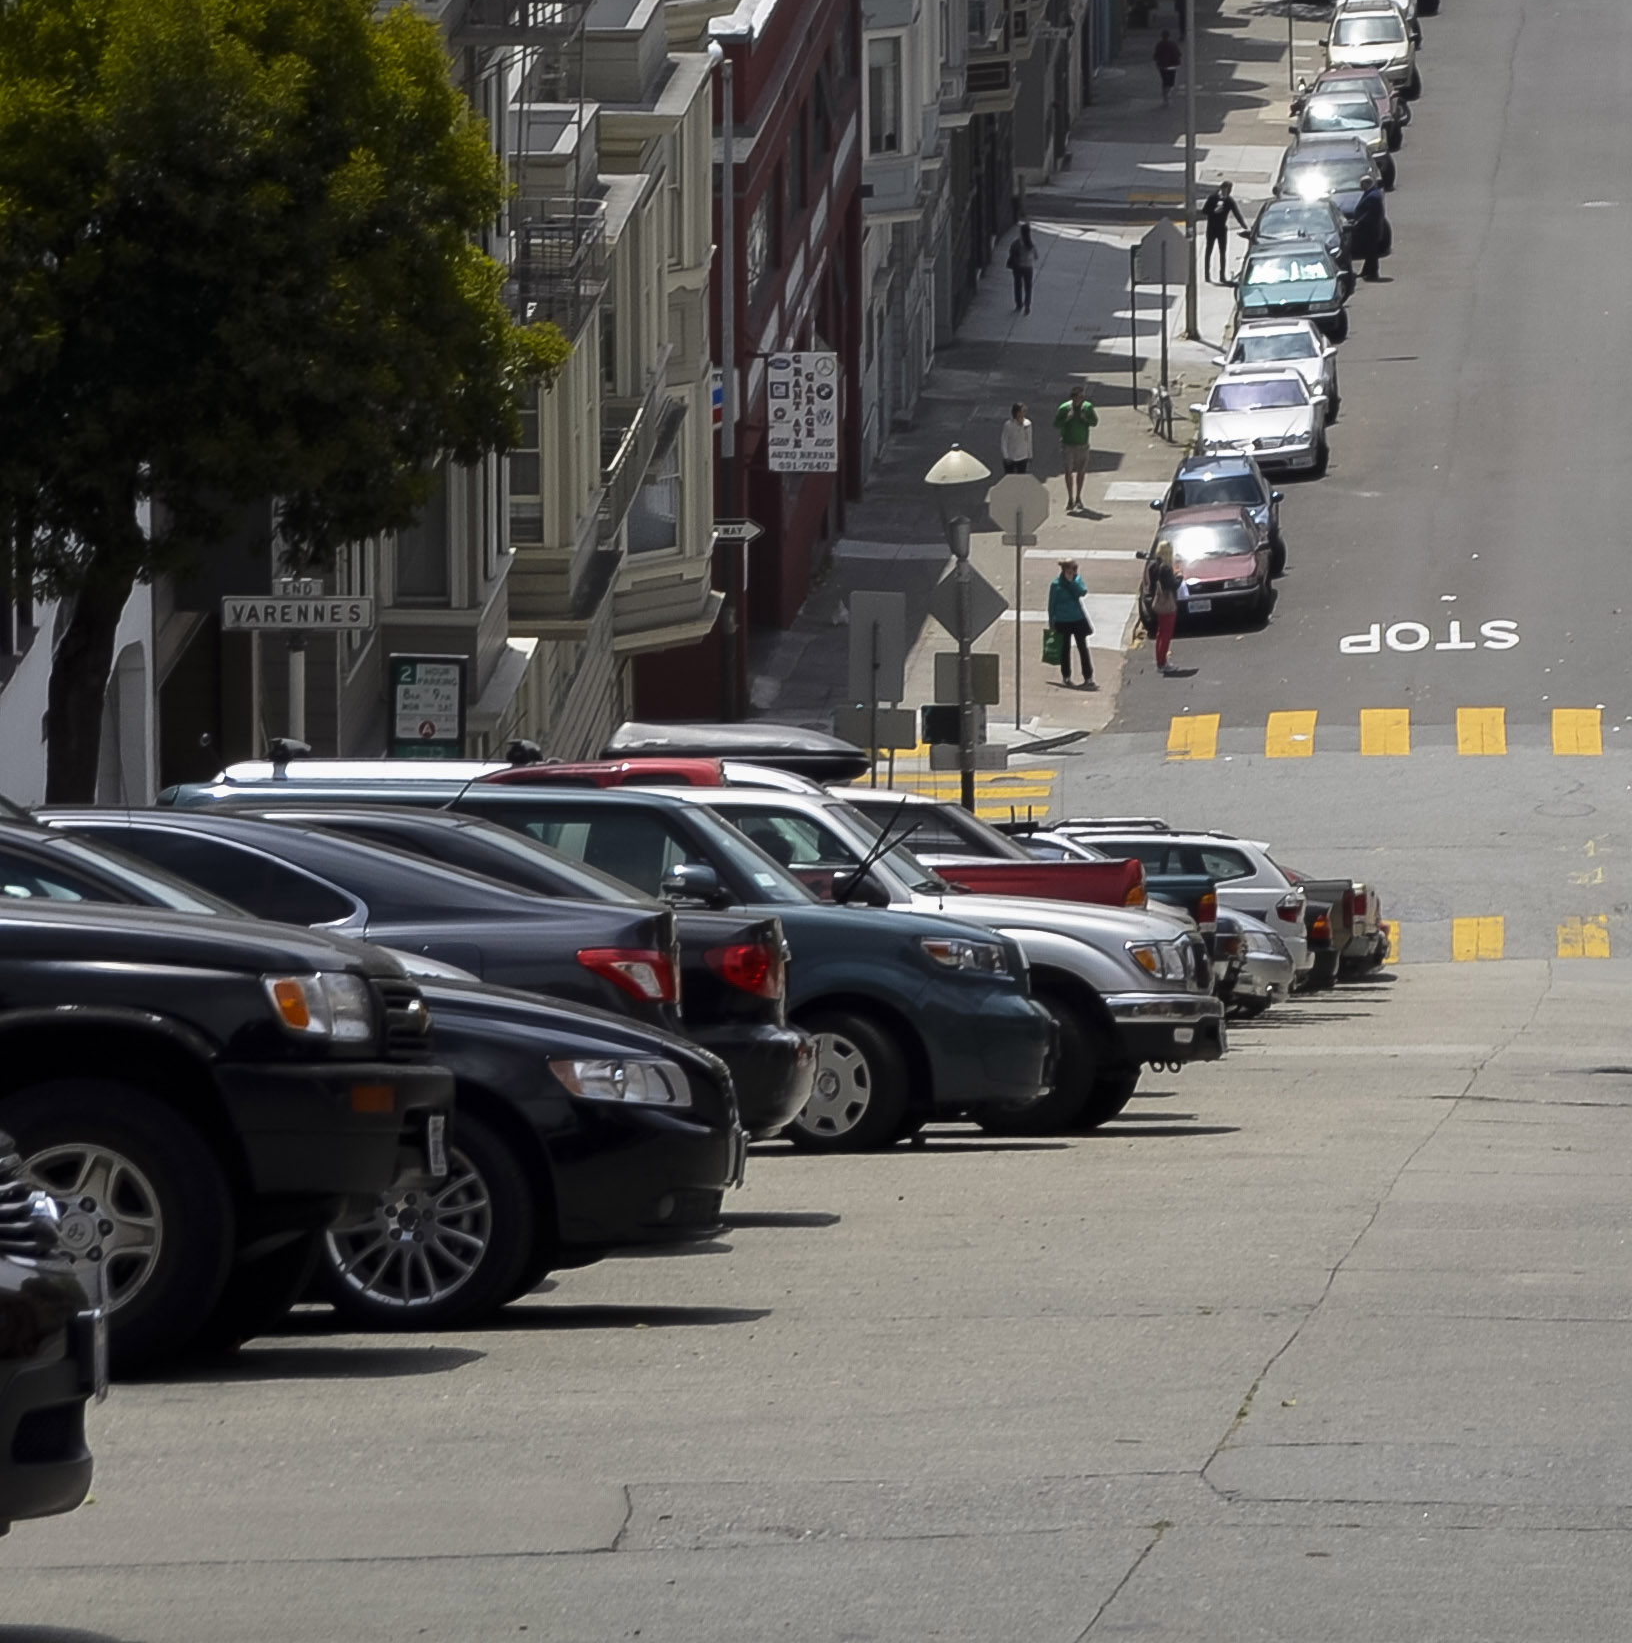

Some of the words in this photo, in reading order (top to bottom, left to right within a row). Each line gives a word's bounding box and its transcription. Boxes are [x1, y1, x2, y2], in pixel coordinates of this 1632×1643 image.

[722, 526, 743, 536] WAY
[282, 583, 313, 595] END
[231, 604, 362, 623] VARENNES
[1340, 619, 1520, 653] STOP
[399, 666, 412, 682] 2
